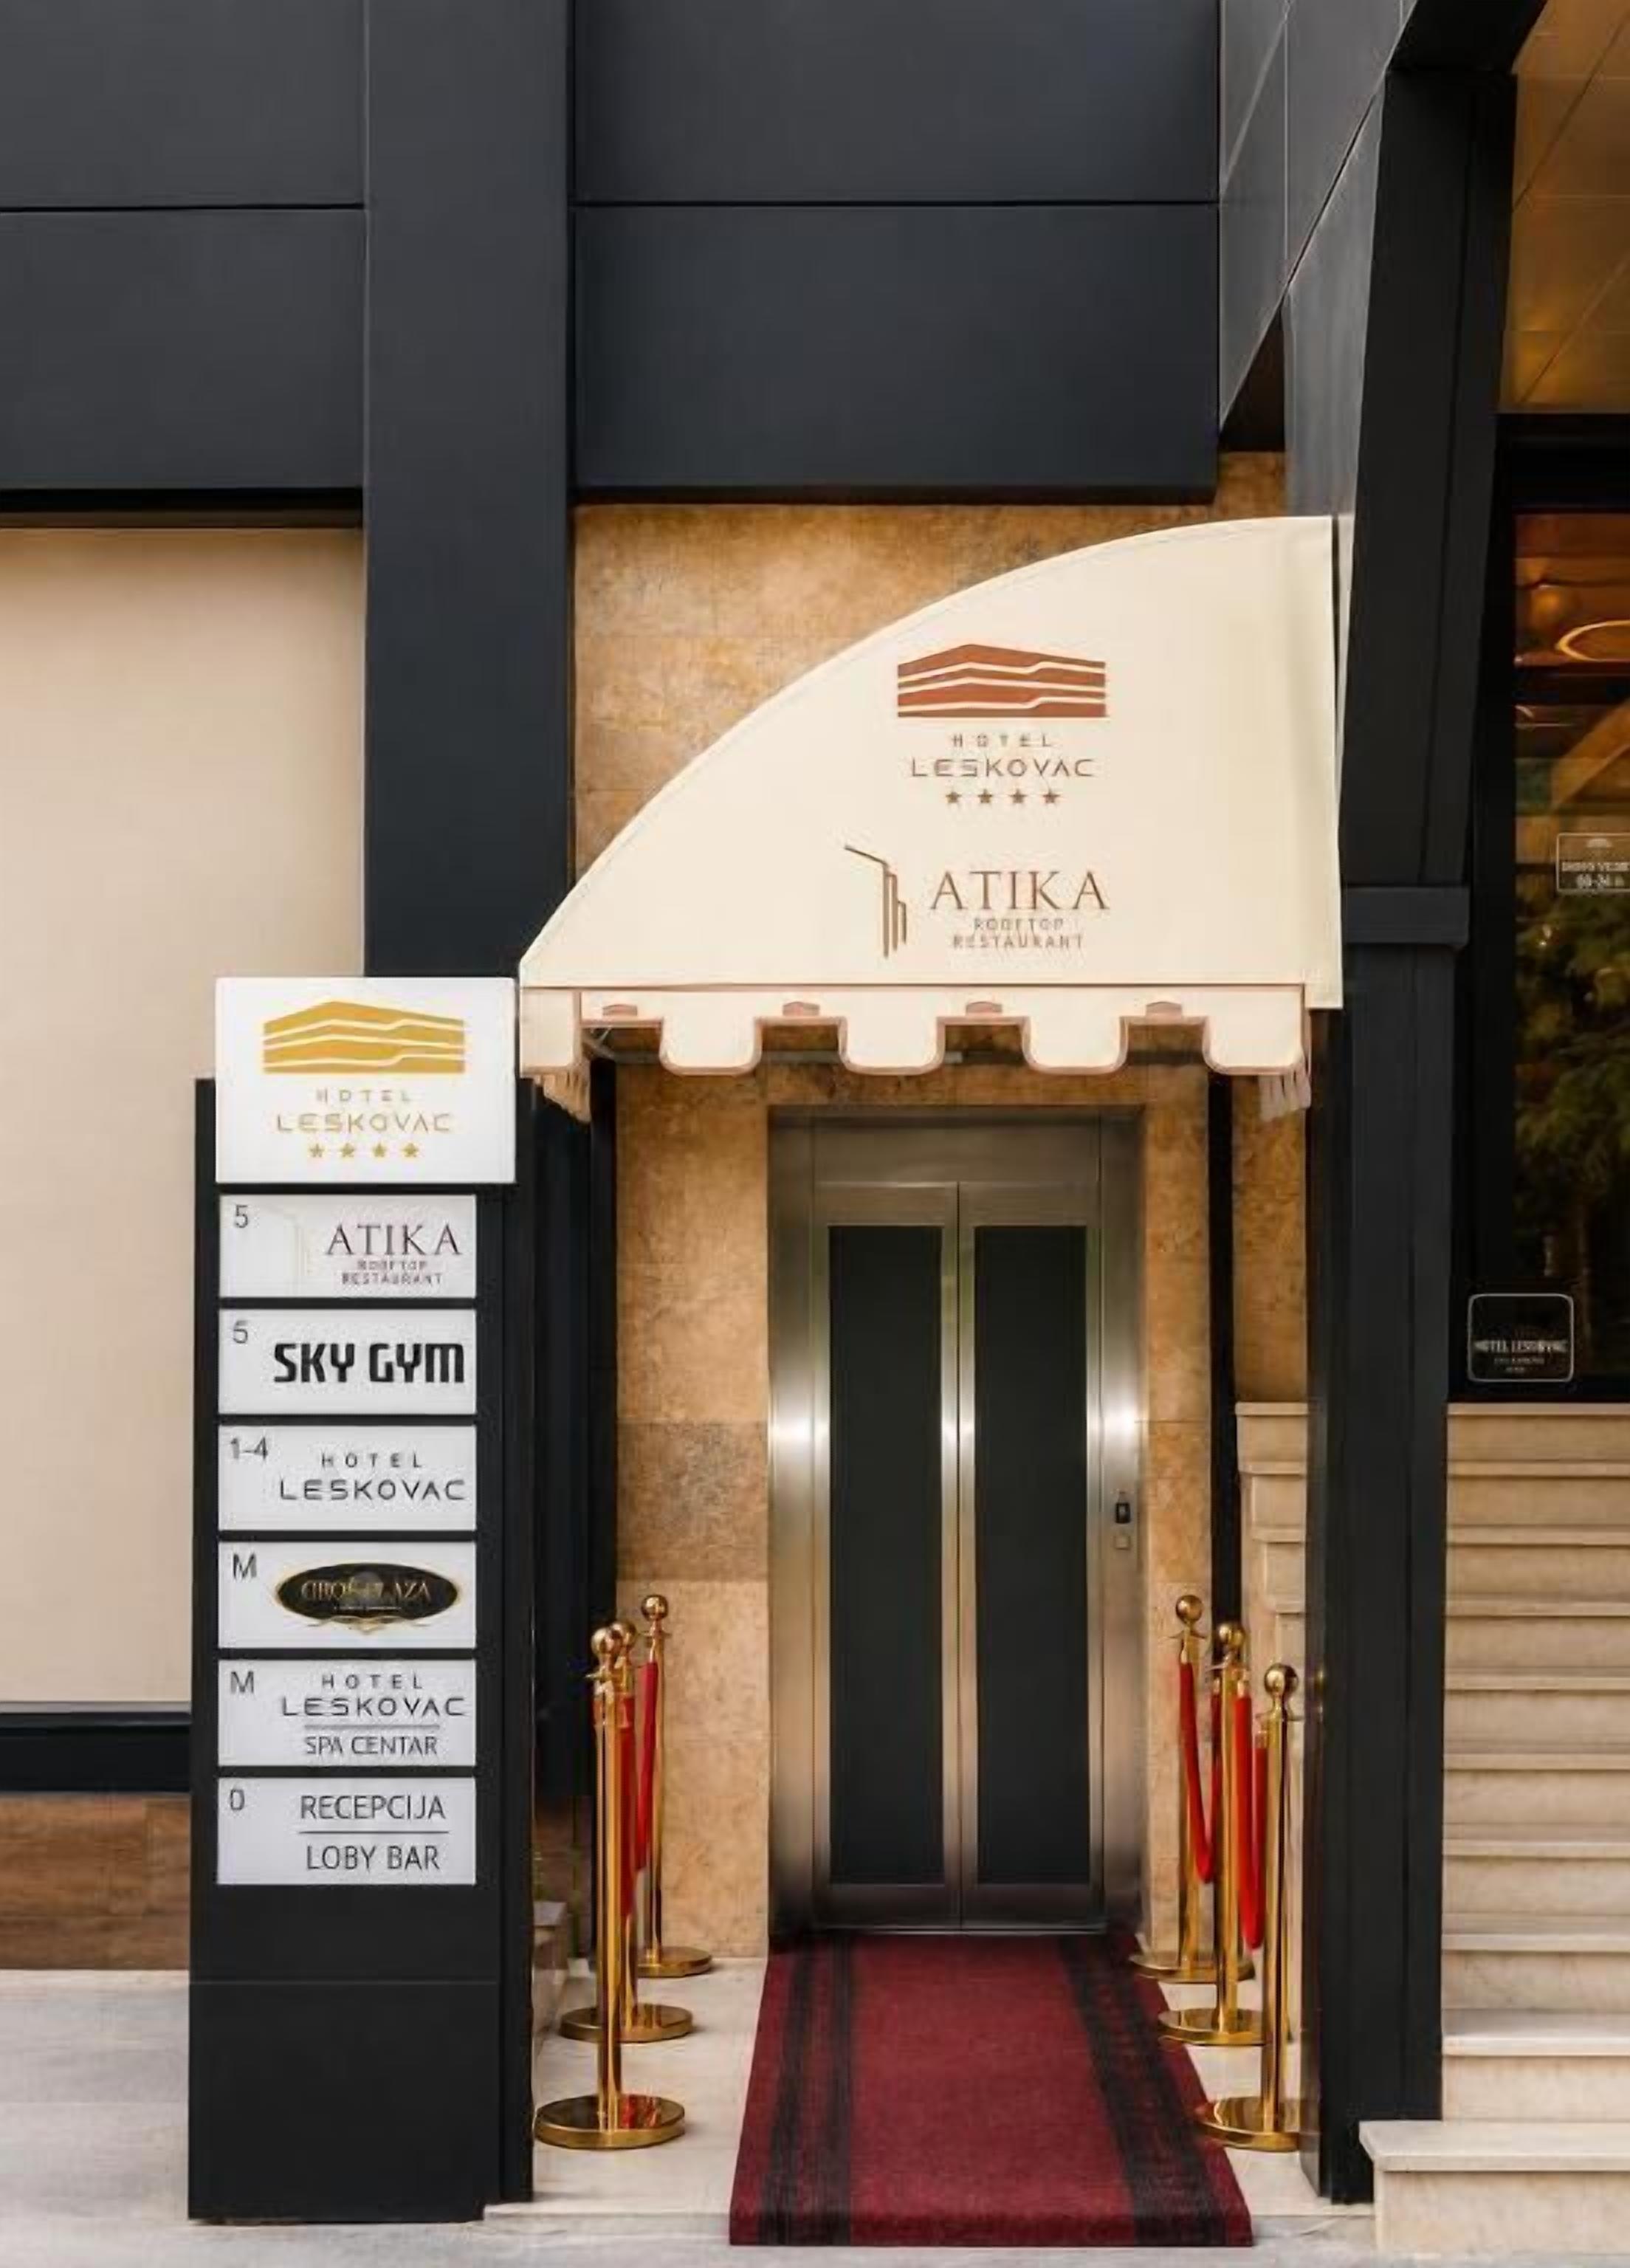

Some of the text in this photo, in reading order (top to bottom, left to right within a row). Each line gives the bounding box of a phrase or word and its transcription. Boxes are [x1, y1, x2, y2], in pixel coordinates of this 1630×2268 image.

[952, 733, 1053, 748] HOTEL
[911, 758, 1094, 778] LESKOVAC
[930, 870, 1110, 911] ATIKA
[974, 918, 1064, 932] ROOFTOP
[952, 935, 1084, 949] RESTAURANT
[316, 1088, 412, 1103] HOTEL
[277, 1113, 452, 1133] LESKOVAC
[234, 1204, 250, 1228] 5
[326, 1224, 462, 1256] ATIKA
[342, 1272, 442, 1285] RESTAURANT
[233, 1319, 249, 1344] 5
[273, 1343, 464, 1383] SKY GYM
[230, 1437, 268, 1460] 1-4
[321, 1452, 422, 1468] HOTEL
[280, 1479, 466, 1501] LESKOVAC
[233, 1553, 257, 1579] M
[230, 1670, 255, 1694] M
[321, 1673, 422, 1689] HOTEL
[282, 1697, 466, 1717] LESKOVAC
[305, 1736, 438, 1756] SPA CENTAR
[300, 1795, 446, 1820] RECEPCIJA
[307, 1845, 440, 1870] LOBY BAR
